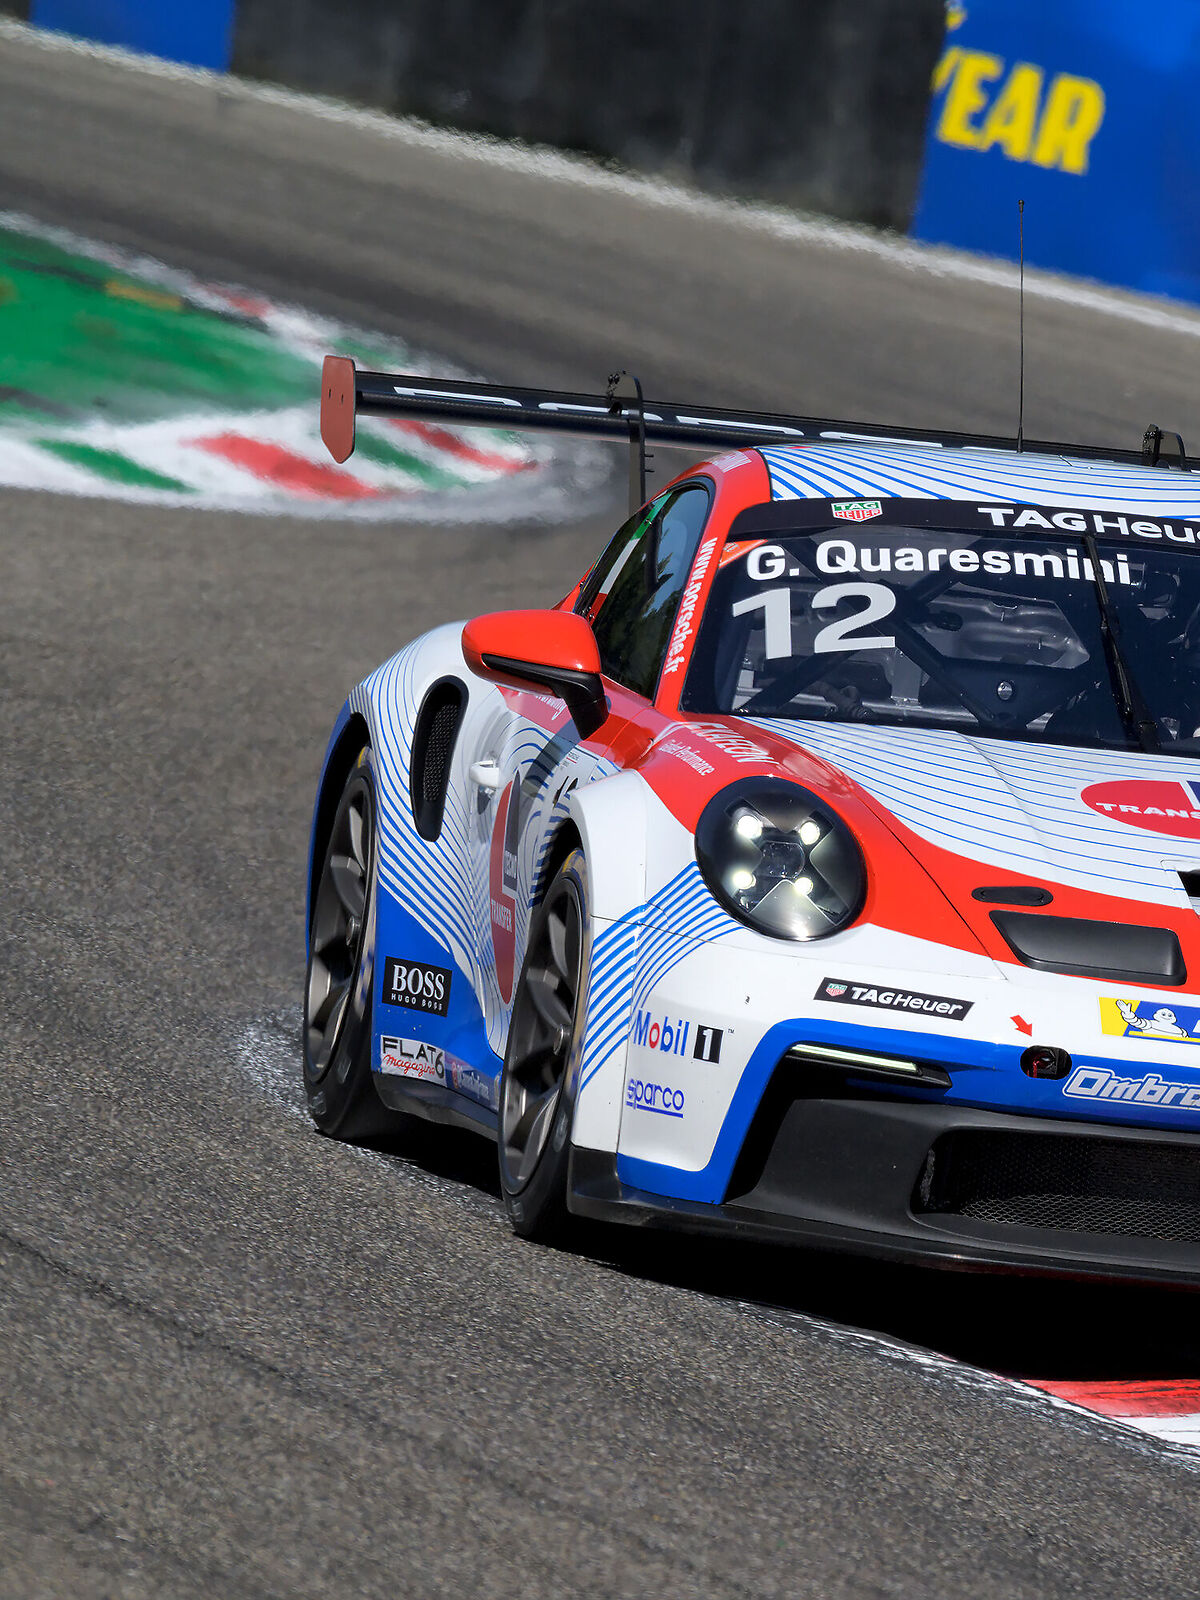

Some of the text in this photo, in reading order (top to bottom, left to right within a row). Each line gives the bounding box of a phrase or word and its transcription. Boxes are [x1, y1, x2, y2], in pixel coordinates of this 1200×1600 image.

[931, 45, 1106, 177] EAR
[835, 509, 880, 520] HEUER
[836, 502, 878, 511] TAG
[747, 539, 1131, 585] G. Quaresmini
[732, 582, 897, 660] 12
[391, 964, 445, 1001] BOSS
[391, 993, 443, 1011] HUGO BOSS
[633, 1009, 690, 1057] Mobil
[627, 1078, 685, 1112] sparco
